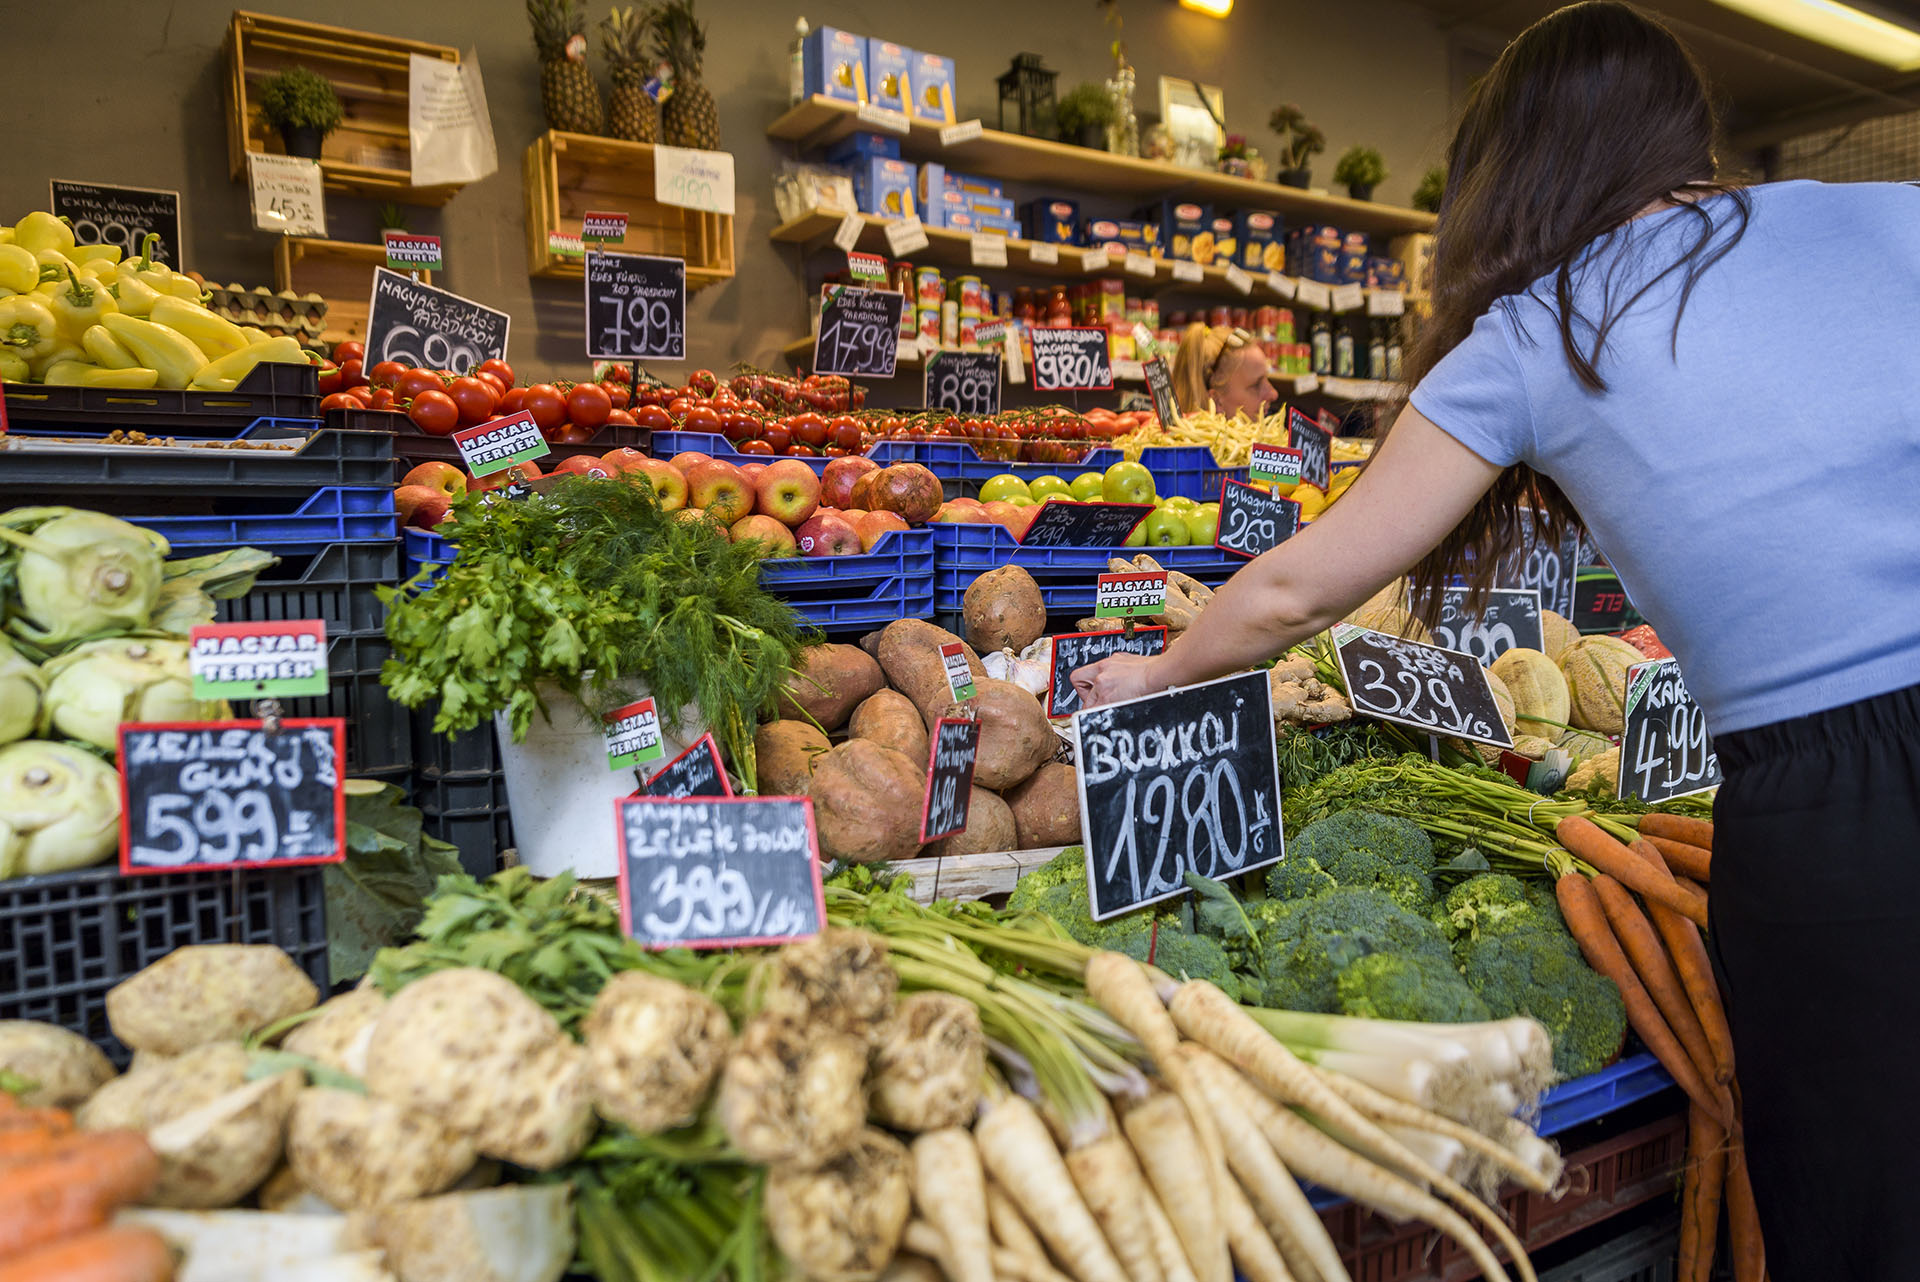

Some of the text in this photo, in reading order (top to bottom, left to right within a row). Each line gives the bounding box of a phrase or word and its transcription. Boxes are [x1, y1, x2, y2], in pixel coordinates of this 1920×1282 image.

[586, 218, 625, 227] MAGYAR
[388, 239, 438, 251] MAGYAR
[390, 251, 437, 263] TERMÉK
[378, 279, 441, 311] MAGYAR
[599, 295, 671, 354] 799
[821, 319, 892, 373] 1799
[940, 373, 991, 415] 899
[461, 420, 535, 452] MAGYAR
[471, 435, 540, 466] TERMÉK
[1253, 449, 1300, 464] MAGYAR
[1254, 461, 1298, 477] TERMÉK
[1219, 507, 1276, 556] 269
[1100, 579, 1164, 594] MAGYAR
[1101, 593, 1161, 609] TERMÉK
[196, 633, 319, 657] MAGYAR
[202, 657, 317, 684] TERMÉK
[943, 653, 968, 669] MAGYAR
[950, 669, 974, 690] TERMÉK
[605, 710, 656, 737] MAGYAR
[609, 731, 658, 759] TERMÉK
[1634, 703, 1707, 799] 499
[129, 788, 280, 867] 599
[1104, 757, 1249, 904] 1280
